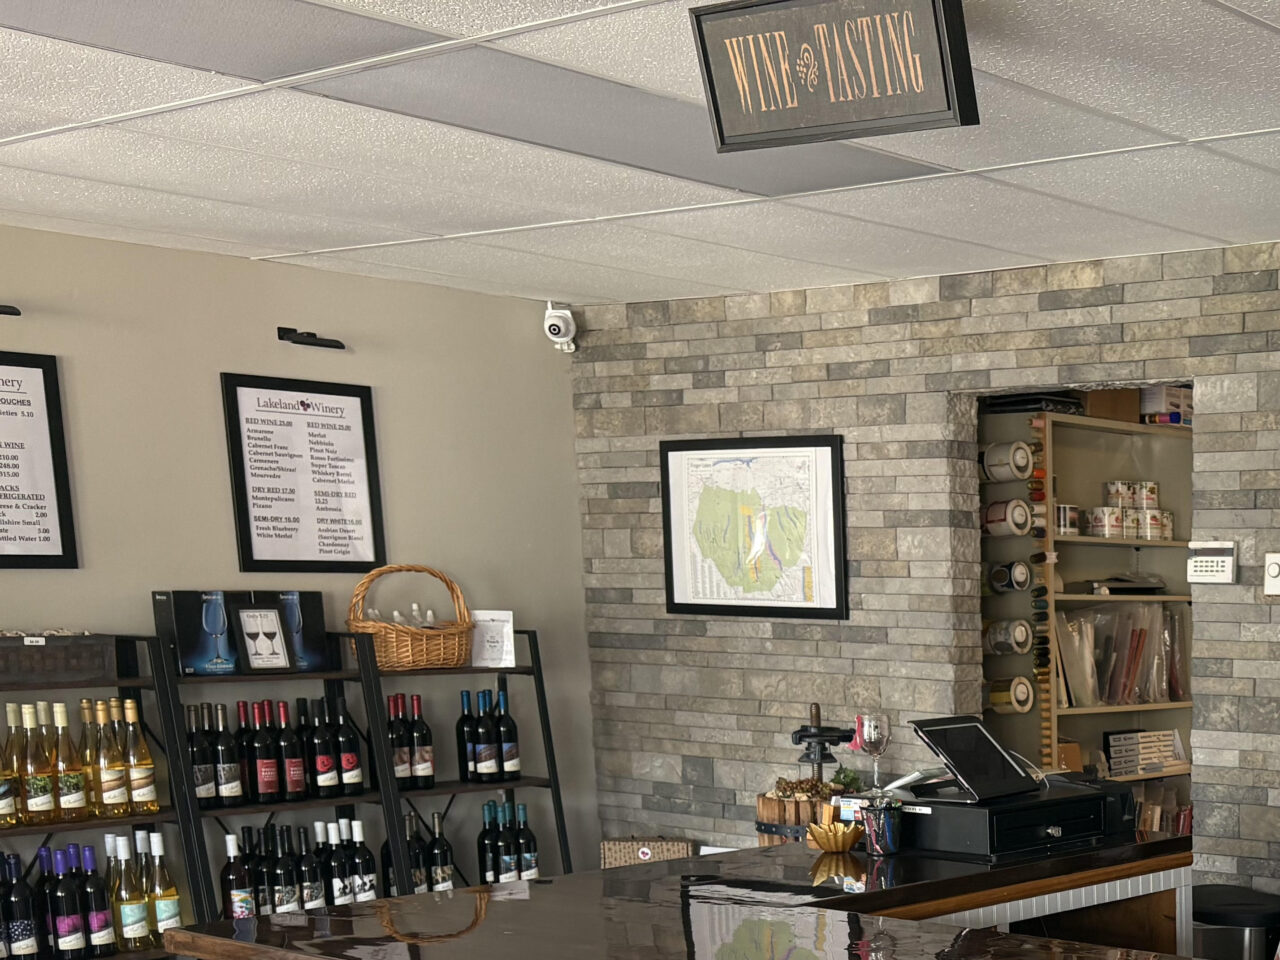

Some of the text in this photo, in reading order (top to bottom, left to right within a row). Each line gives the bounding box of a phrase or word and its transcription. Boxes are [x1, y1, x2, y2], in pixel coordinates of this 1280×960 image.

[724, 10, 924, 114] WINE TASTING
[257, 397, 345, 418] Lakeland Winery
[246, 417, 259, 425] RED
[260, 418, 278, 426] WINE
[4, 442, 25, 450] WINE
